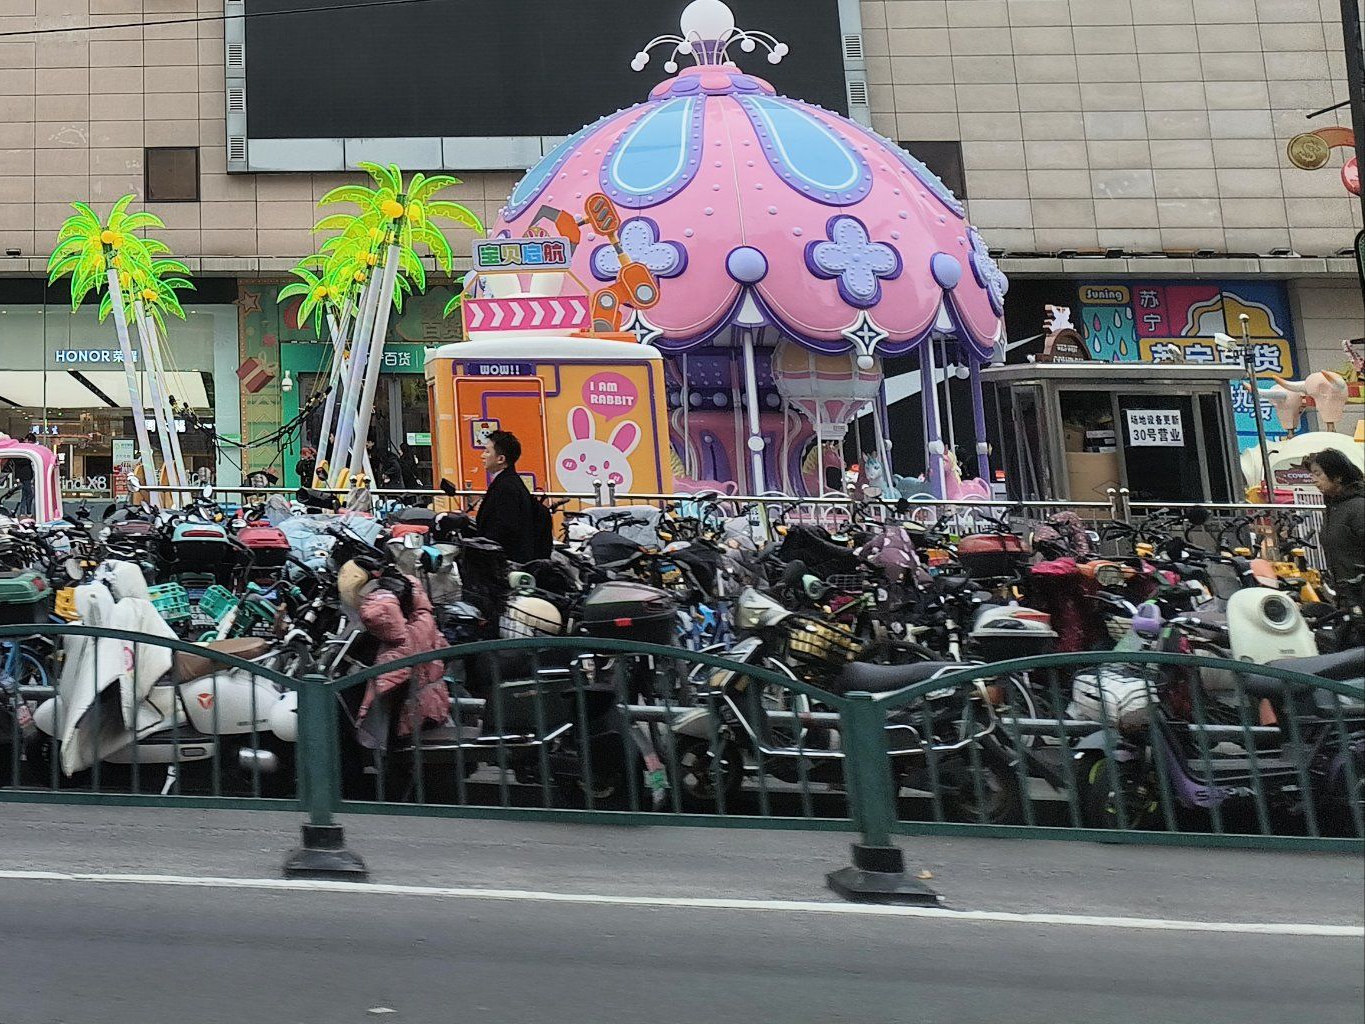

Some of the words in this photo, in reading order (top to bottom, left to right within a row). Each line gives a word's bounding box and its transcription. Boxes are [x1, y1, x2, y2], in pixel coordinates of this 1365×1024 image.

[479, 242, 566, 266] 宝贝启航
[1086, 289, 1122, 301] Suning
[1139, 290, 1161, 331] 苏宁
[55, 350, 110, 362] HONOR
[480, 365, 520, 375] WOW!!
[590, 381, 594, 391] I
[599, 382, 618, 392] AM
[590, 395, 634, 406] RABBIT
[1131, 414, 1180, 426] 场地设备更新
[1133, 428, 1182, 442] 30号营业
[87, 476, 107, 489] X8
